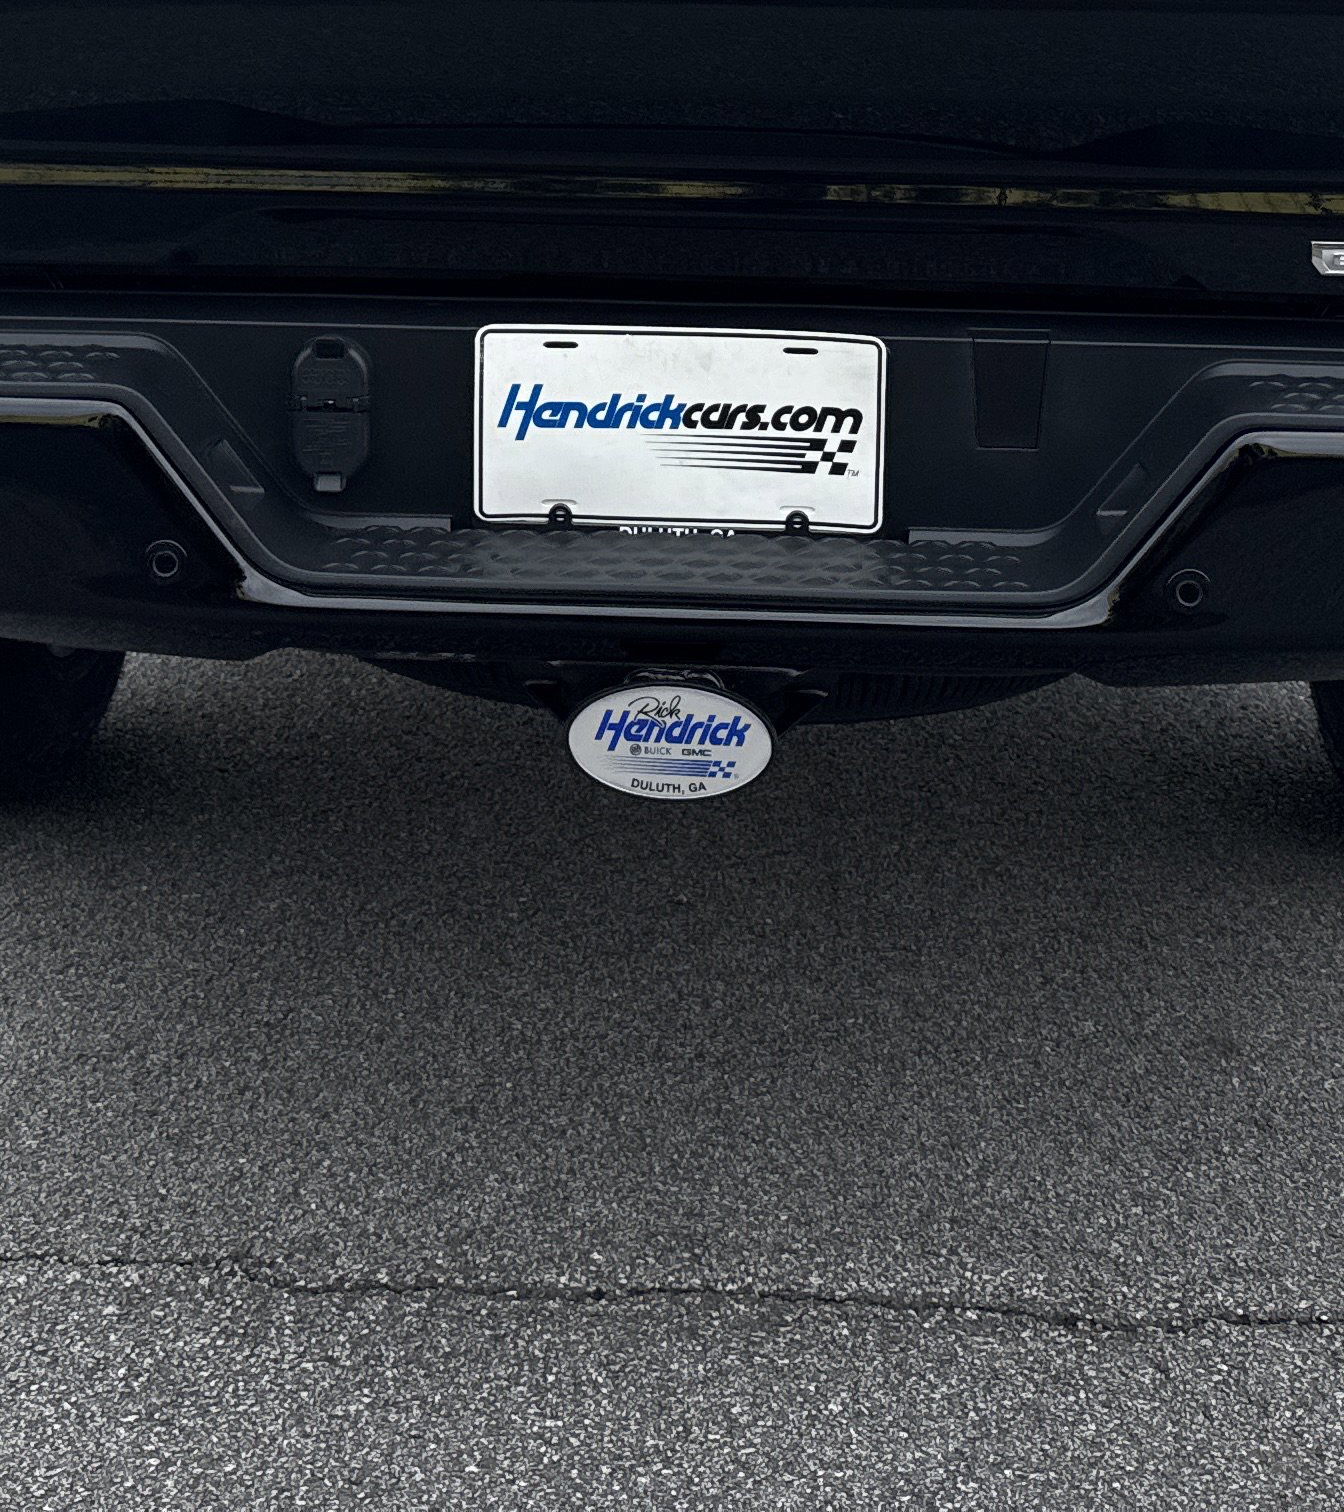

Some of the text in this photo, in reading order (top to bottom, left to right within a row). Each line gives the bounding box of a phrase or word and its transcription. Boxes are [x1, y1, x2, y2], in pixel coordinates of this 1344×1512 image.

[497, 383, 864, 441] Hendrickcars.com
[628, 695, 681, 728] Rick
[594, 709, 752, 752] Hendrick
[644, 746, 712, 757] BUICK GMC
[630, 778, 707, 795] DULUTH, GA
